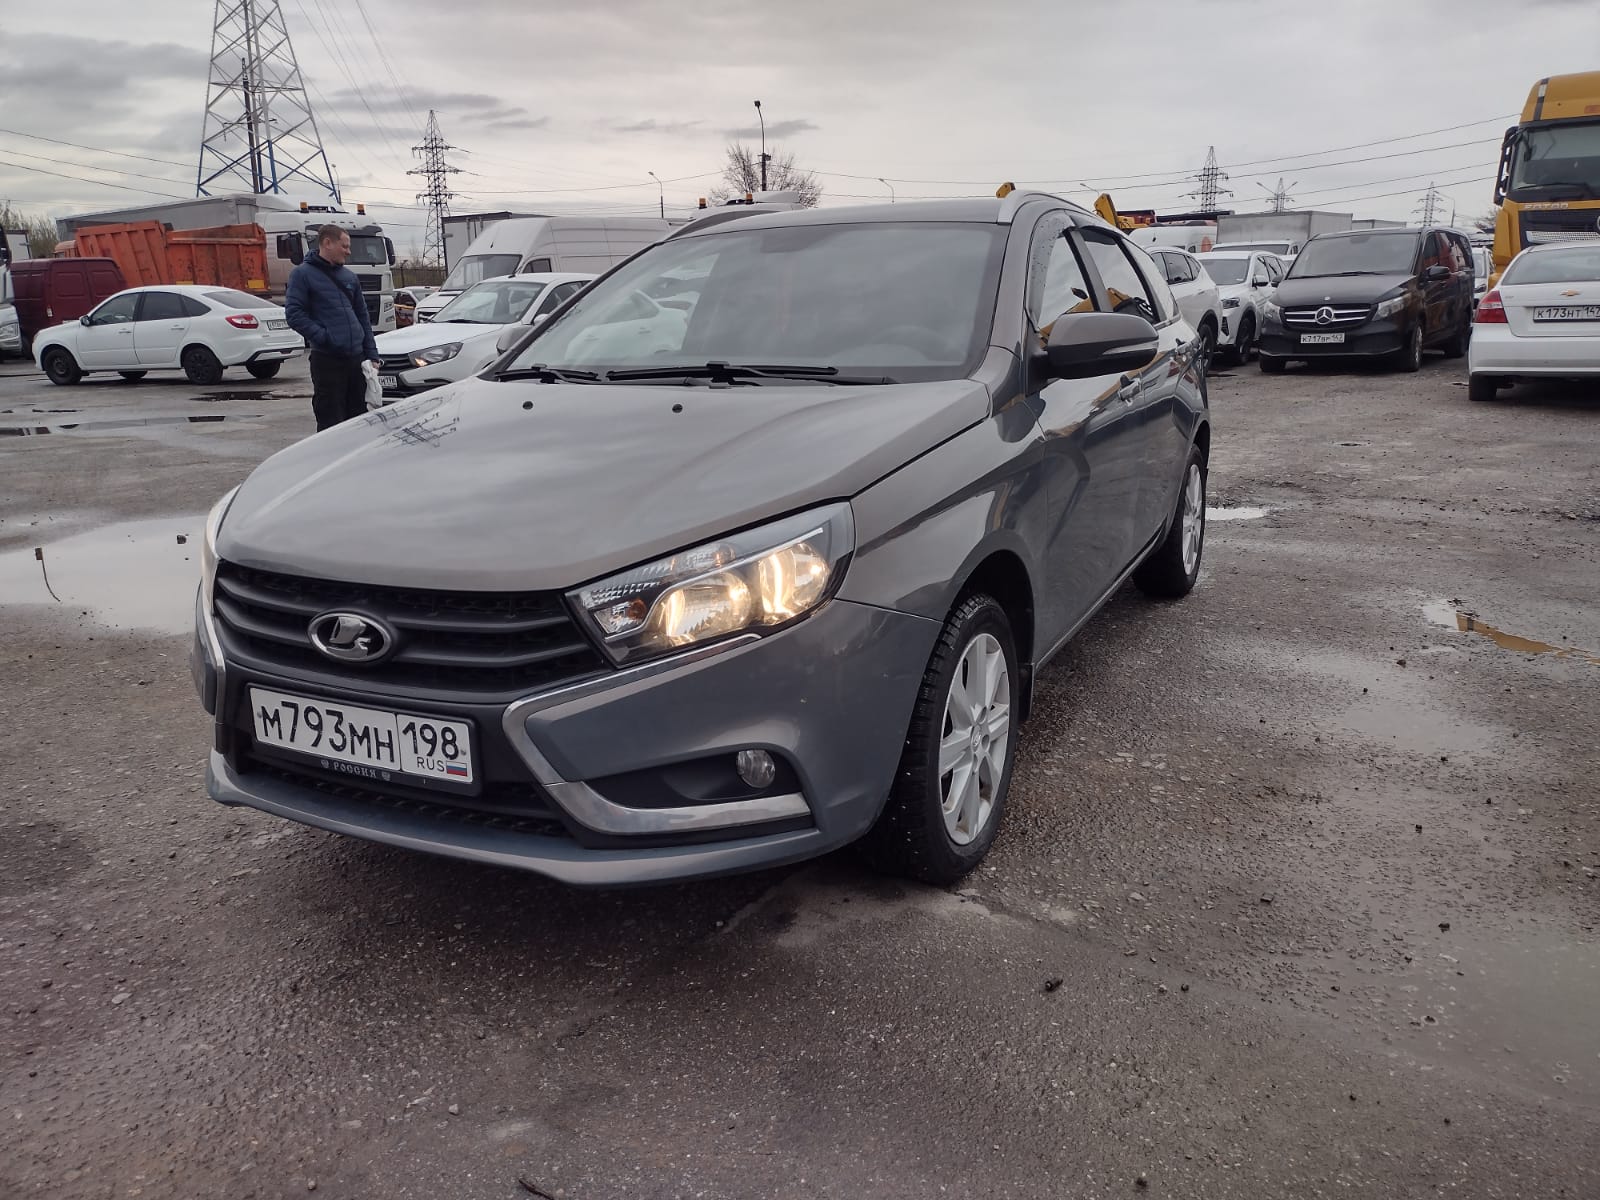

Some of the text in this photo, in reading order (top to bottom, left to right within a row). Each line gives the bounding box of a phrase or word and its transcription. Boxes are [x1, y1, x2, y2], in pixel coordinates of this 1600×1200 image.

[1537, 307, 1581, 318] К173НТ
[260, 700, 460, 763] М793МН 198
[333, 761, 377, 779] РОССИЯ
[416, 756, 446, 772] RUS
